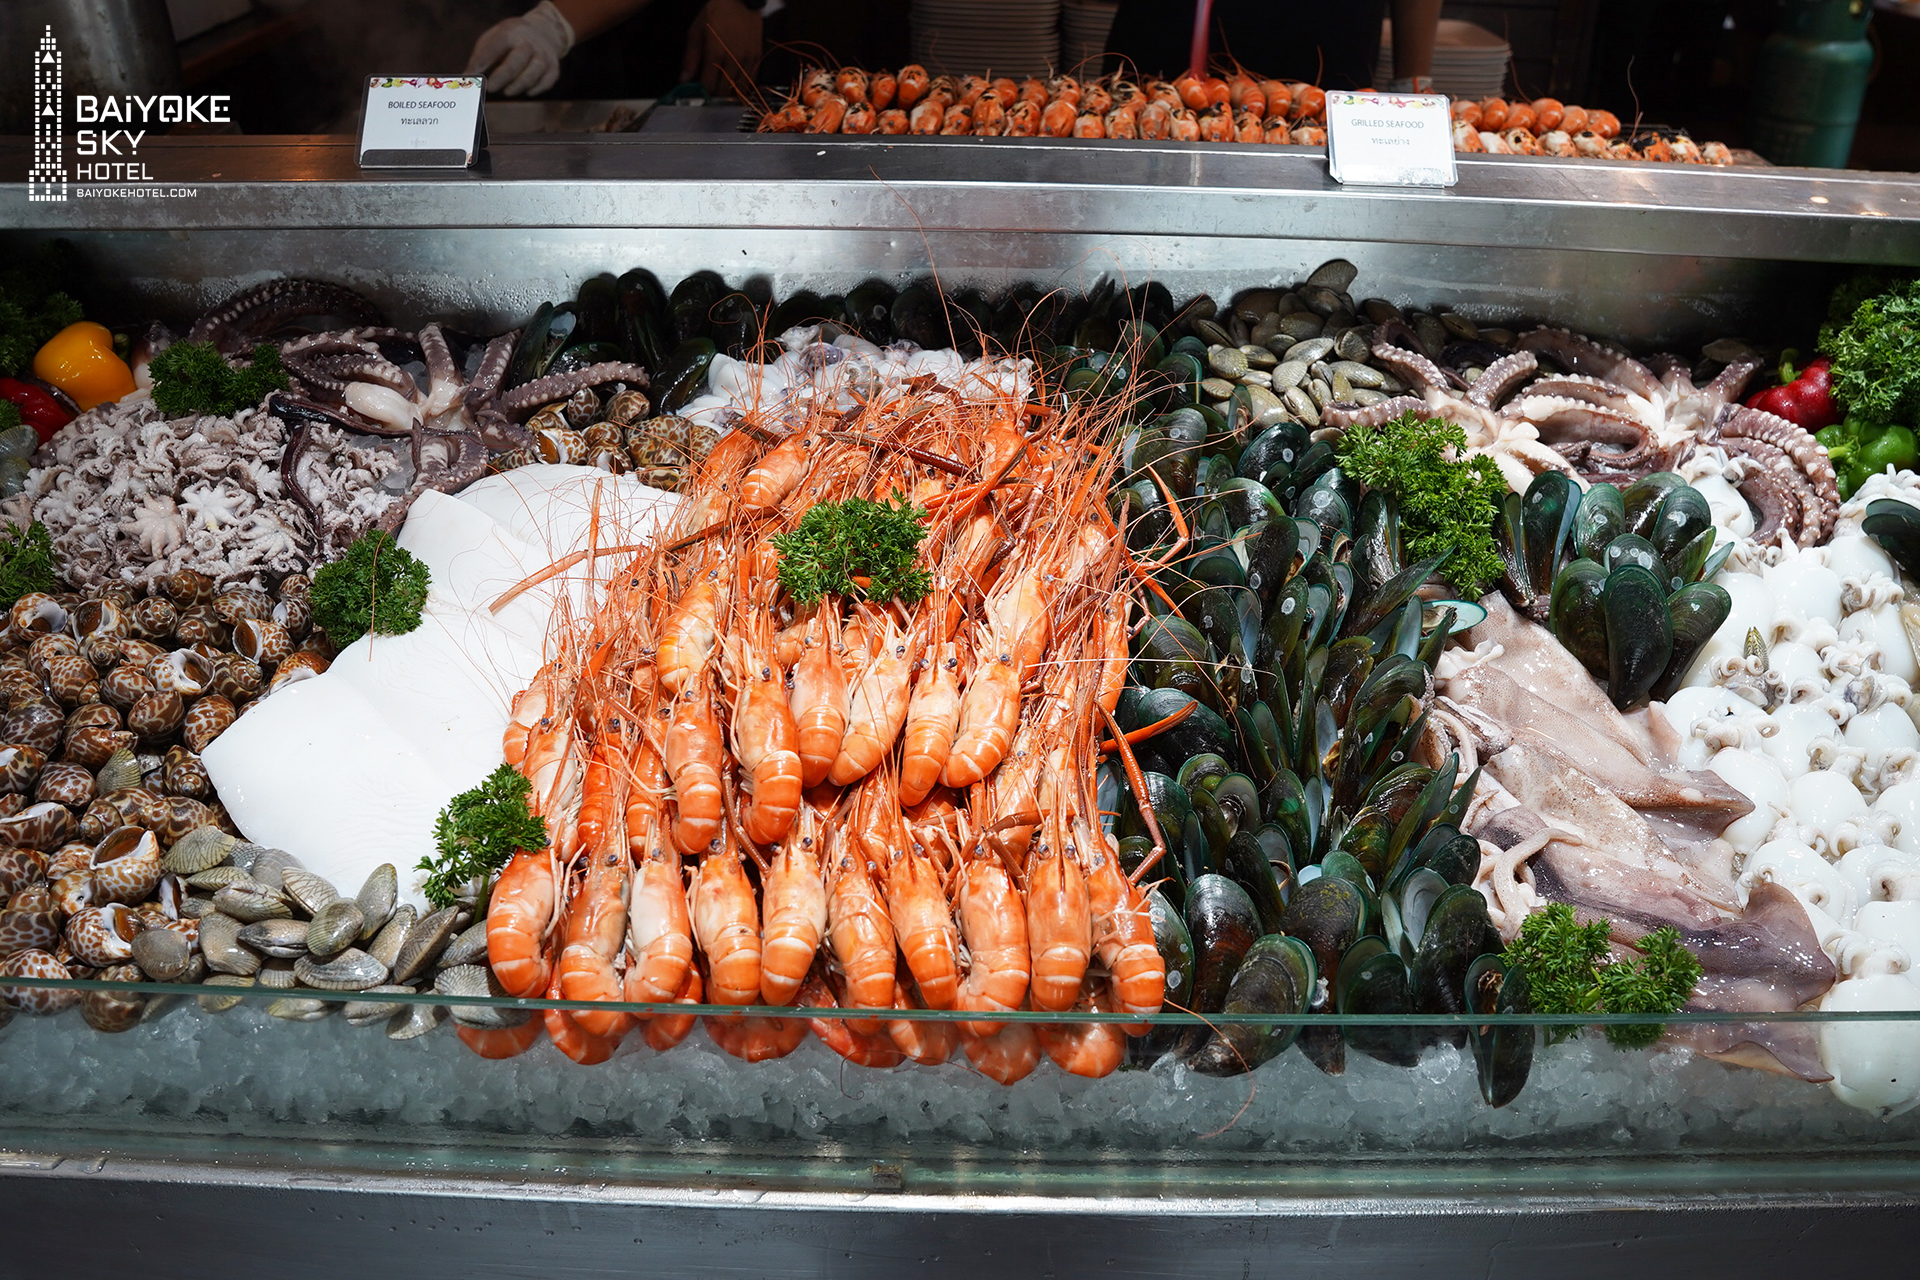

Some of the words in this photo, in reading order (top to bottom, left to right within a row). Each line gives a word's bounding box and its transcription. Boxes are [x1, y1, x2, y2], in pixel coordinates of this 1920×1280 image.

[388, 101, 417, 109] BOILED
[418, 101, 456, 109] SEAFOOD
[401, 117, 439, 125] ทะเลลวก
[1351, 119, 1384, 128] GRILLED
[1385, 120, 1424, 129] SEAFOOD
[1371, 135, 1410, 146] ทะเลย่าง
